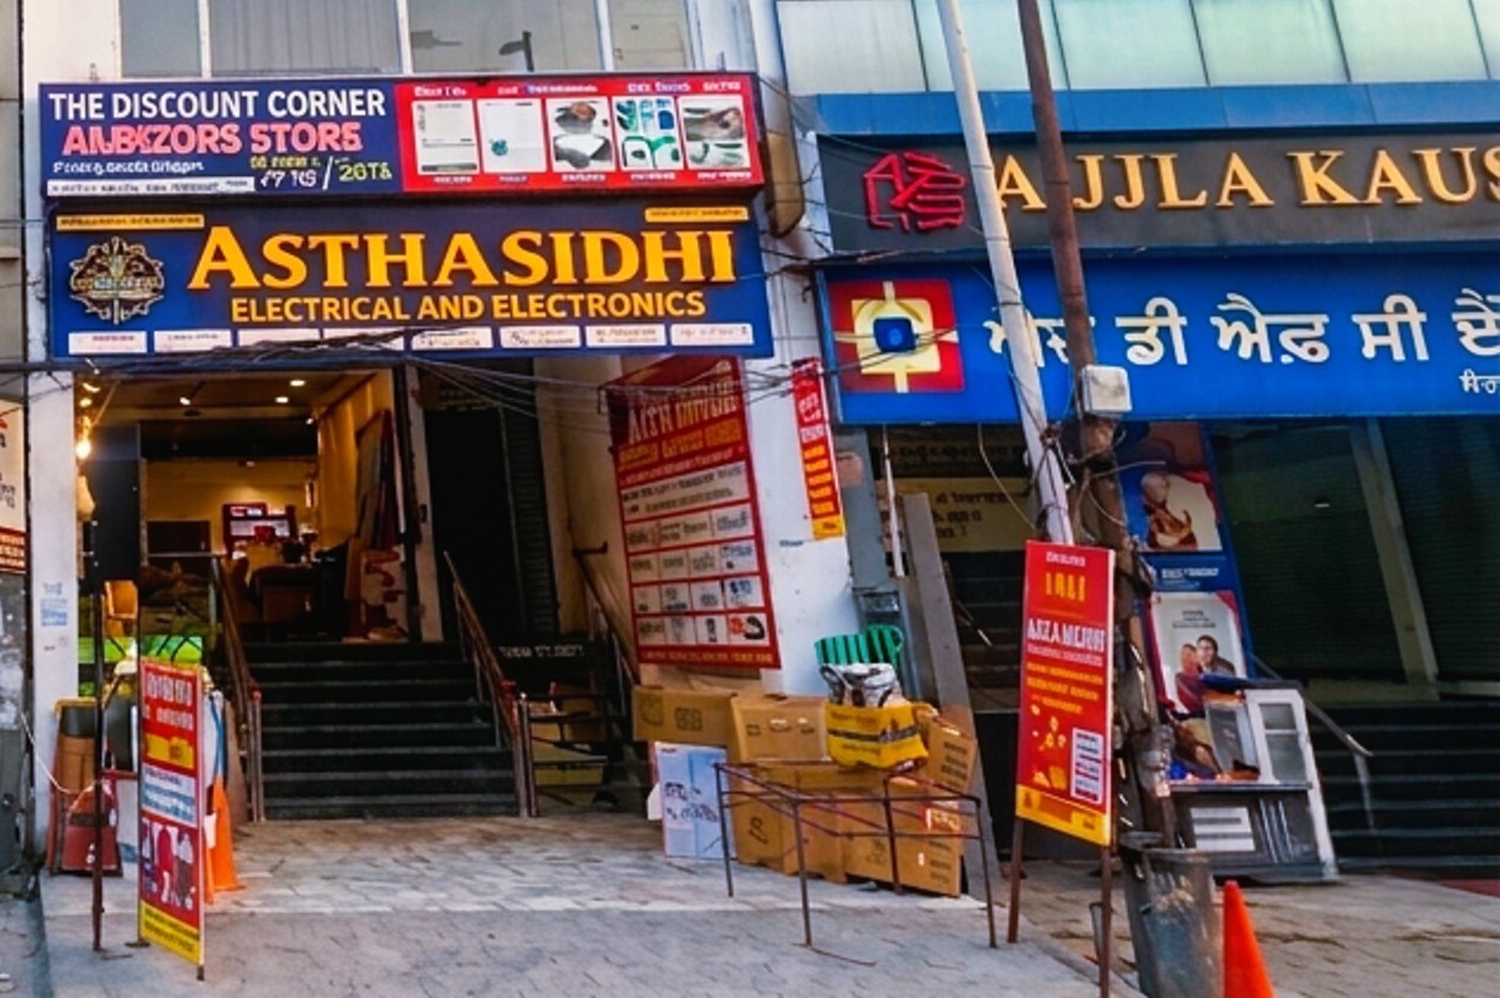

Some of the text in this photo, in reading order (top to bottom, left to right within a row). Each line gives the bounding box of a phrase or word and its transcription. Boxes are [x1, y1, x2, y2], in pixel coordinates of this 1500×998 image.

[49, 92, 106, 121] THE
[112, 91, 260, 119] DISCOUNT
[267, 89, 386, 118] CORNER
[186, 224, 738, 291] ASTHASIDHI
[231, 290, 706, 323] ELECTRICAL AND ELECTRONICS
[1352, 294, 1430, 361] ਸੀ
